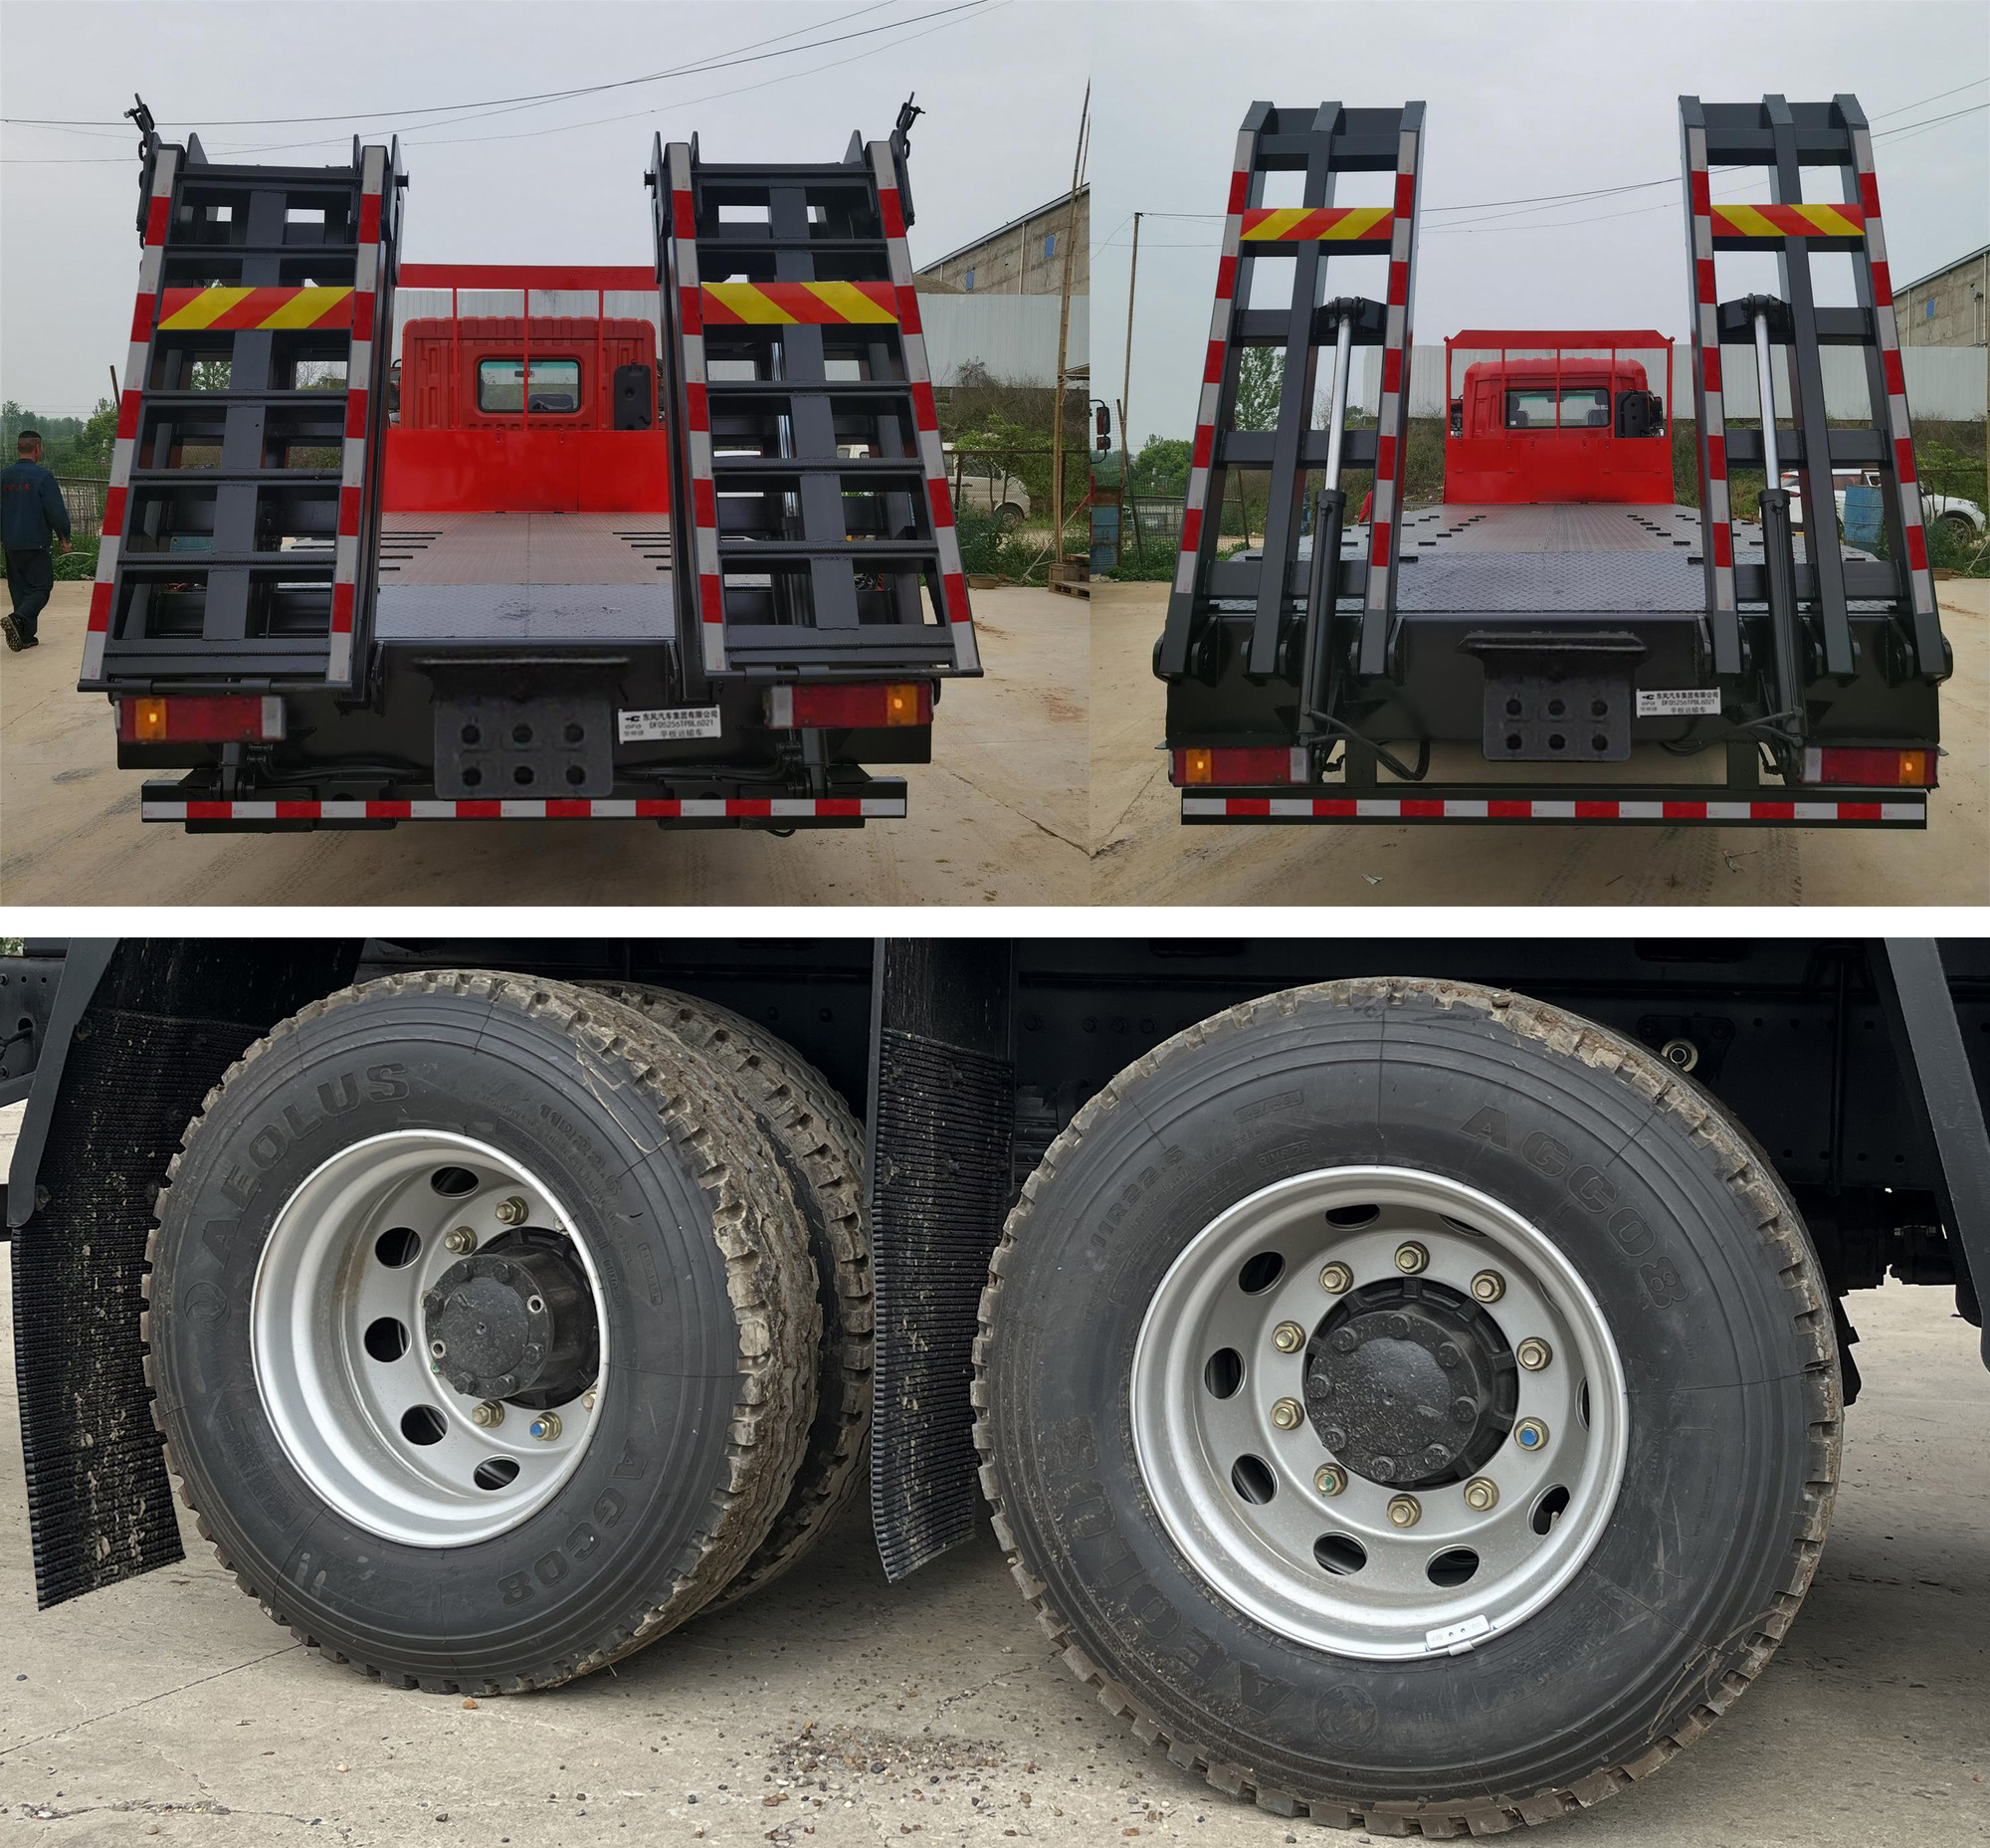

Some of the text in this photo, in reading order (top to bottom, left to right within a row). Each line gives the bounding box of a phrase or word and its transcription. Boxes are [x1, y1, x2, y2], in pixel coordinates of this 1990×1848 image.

[660, 727, 702, 738] 平板运输车
[200, 1062, 411, 1270] AEOLUS
[538, 1104, 624, 1197] 11R22.5
[1092, 1144, 1184, 1247] 11R22.5
[1458, 1103, 1691, 1312] AGC08
[498, 1449, 650, 1608] AGC08
[1053, 1415, 1299, 1716] AEOLUS
